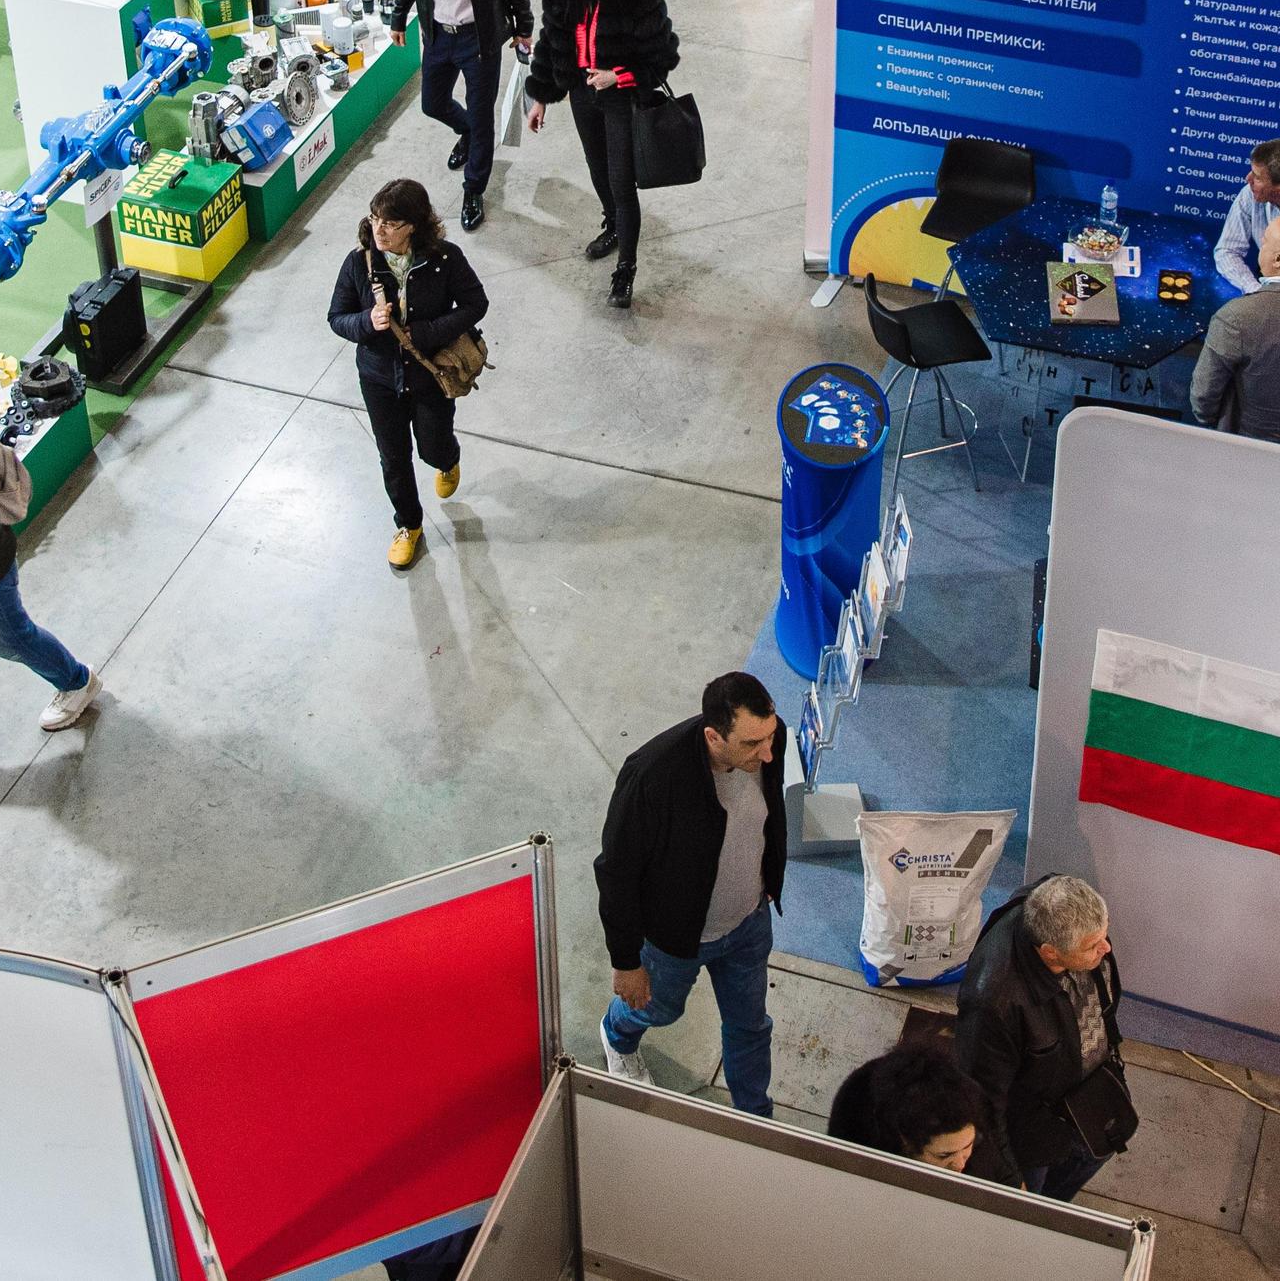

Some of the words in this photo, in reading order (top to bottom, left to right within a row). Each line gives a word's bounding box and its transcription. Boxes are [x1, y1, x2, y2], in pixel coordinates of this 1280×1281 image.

[1193, 13, 1236, 27] жълтък
[878, 13, 963, 37] СПЕЦИАЛНИ
[966, 28, 1045, 51] ПРЕМИКСИ:
[1192, 32, 1249, 50] Витамини,
[887, 45, 934, 61] Ензимни
[937, 55, 994, 73] премикси;
[1189, 47, 1260, 67] обогатяване
[1263, 59, 1277, 69] на
[886, 80, 951, 101] Beautyshell;
[887, 63, 934, 79] Премикс
[946, 74, 1005, 92] органичен
[1008, 84, 1044, 99] селен;
[1184, 107, 1216, 121] Течни
[1218, 113, 1278, 130] витаминни
[1181, 126, 1215, 141] Други
[1180, 146, 1214, 160] Пълна
[1217, 153, 1242, 164] гама
[123, 151, 173, 195] MANN
[139, 155, 190, 199] FILTER
[1177, 166, 1205, 178] Соев
[89, 176, 112, 202] SPICER
[201, 174, 241, 223] MANN
[1175, 184, 1214, 200] Датско
[122, 202, 191, 230] MANN
[204, 191, 242, 241] FILTER
[1174, 204, 1202, 217] МКФ,
[124, 218, 193, 244] FILTER
[908, 854, 952, 863] CHRISTA
